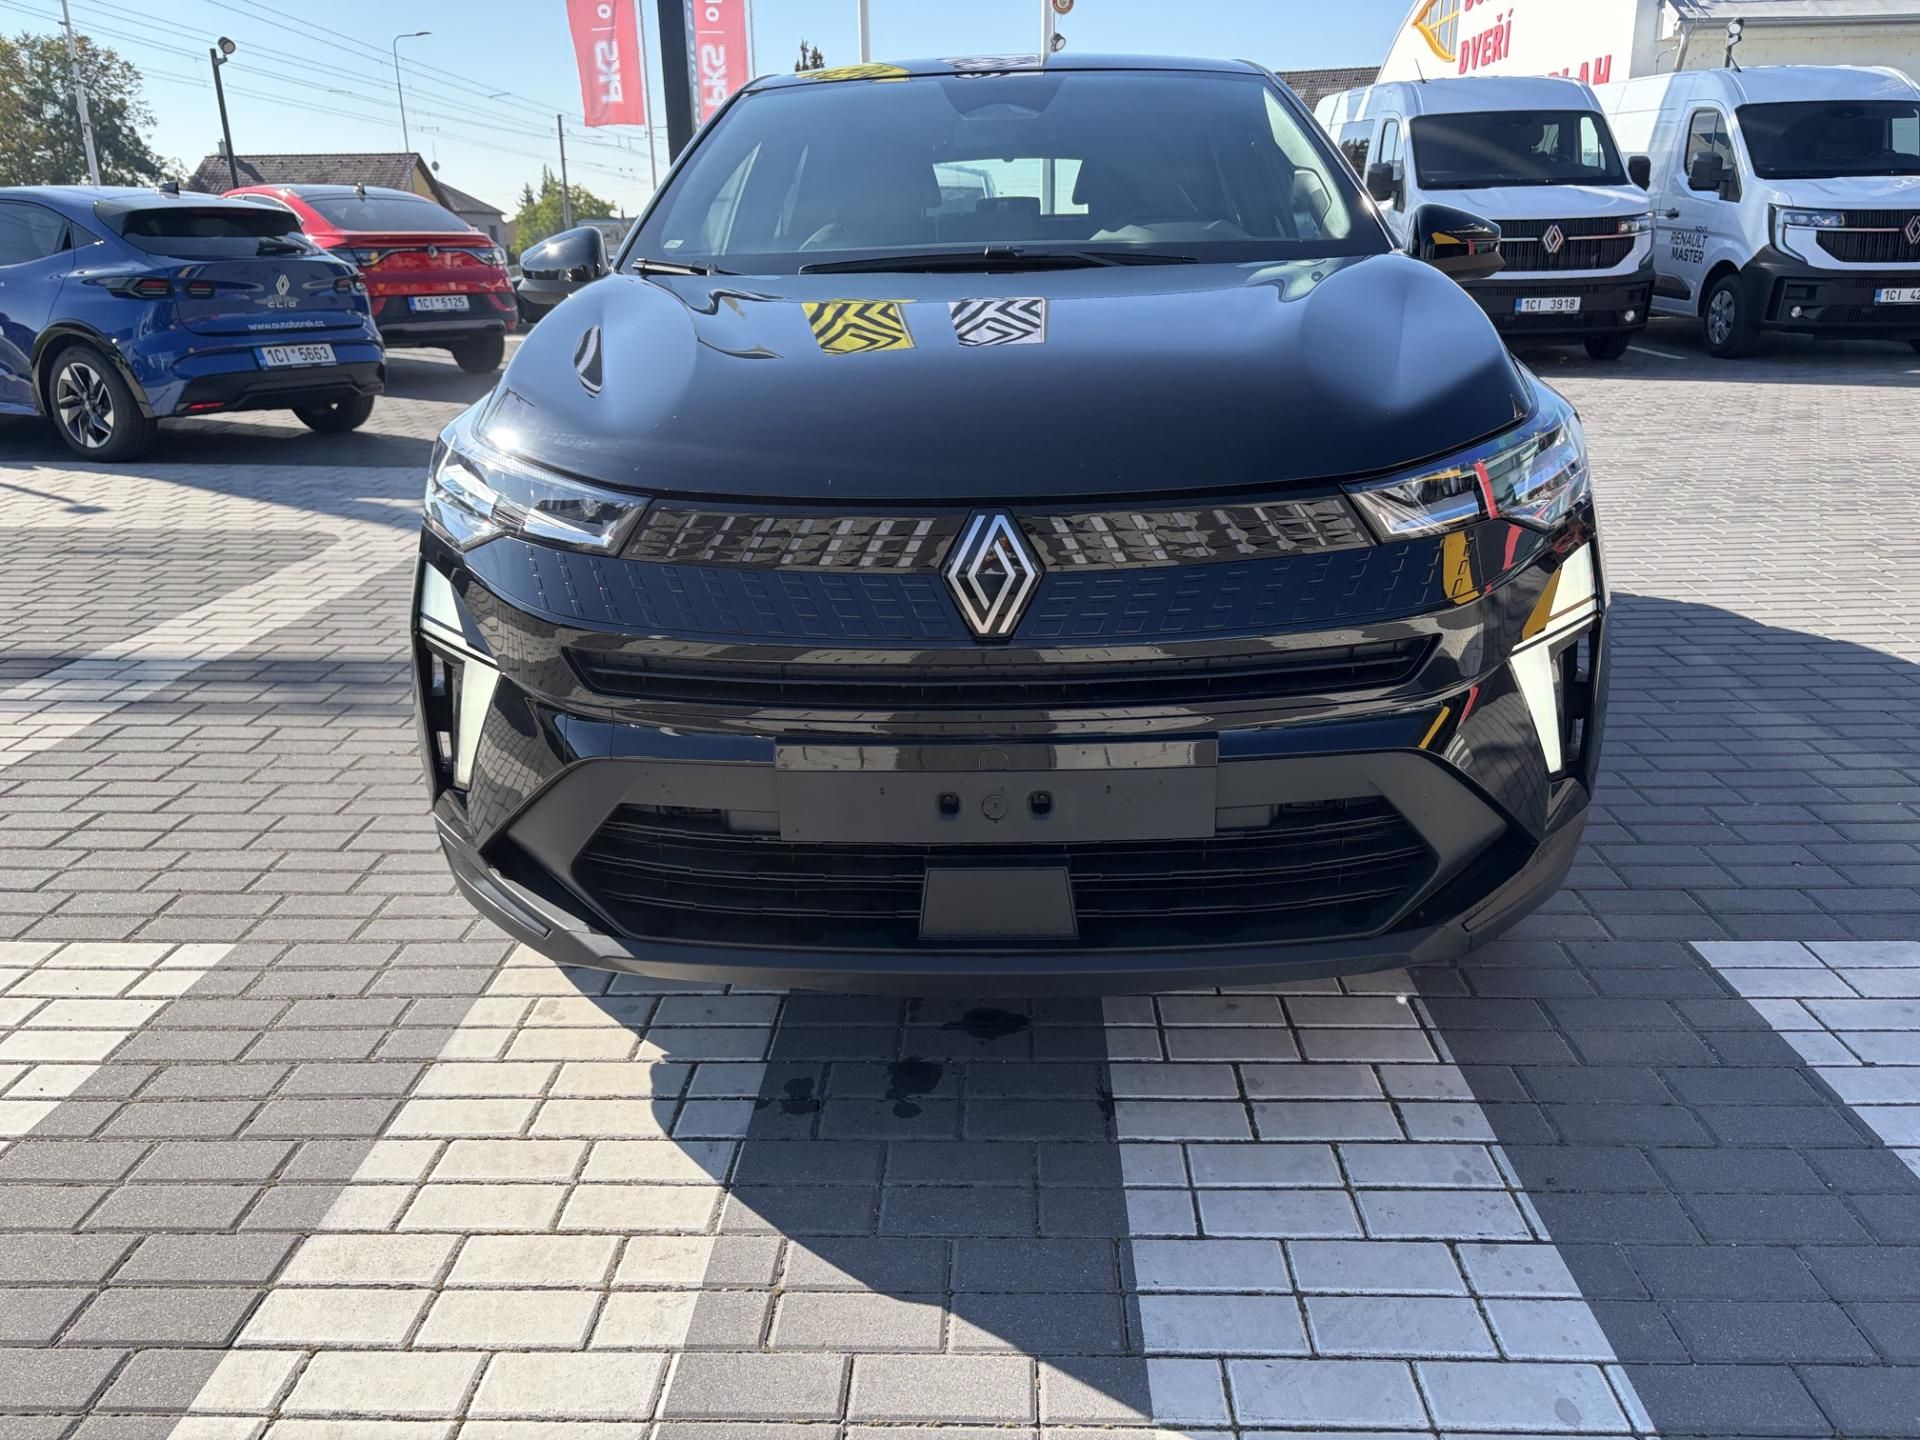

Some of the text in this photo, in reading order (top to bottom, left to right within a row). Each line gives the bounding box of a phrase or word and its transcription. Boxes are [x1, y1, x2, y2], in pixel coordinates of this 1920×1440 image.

[1458, 8, 1513, 75] DVEŘÍ
[1671, 231, 1708, 249] RENAULT
[1671, 246, 1704, 265] MASTER
[267, 301, 297, 309] CLIO
[440, 296, 466, 308] 5125
[1550, 298, 1576, 310] 3918
[297, 346, 330, 362] 5663
